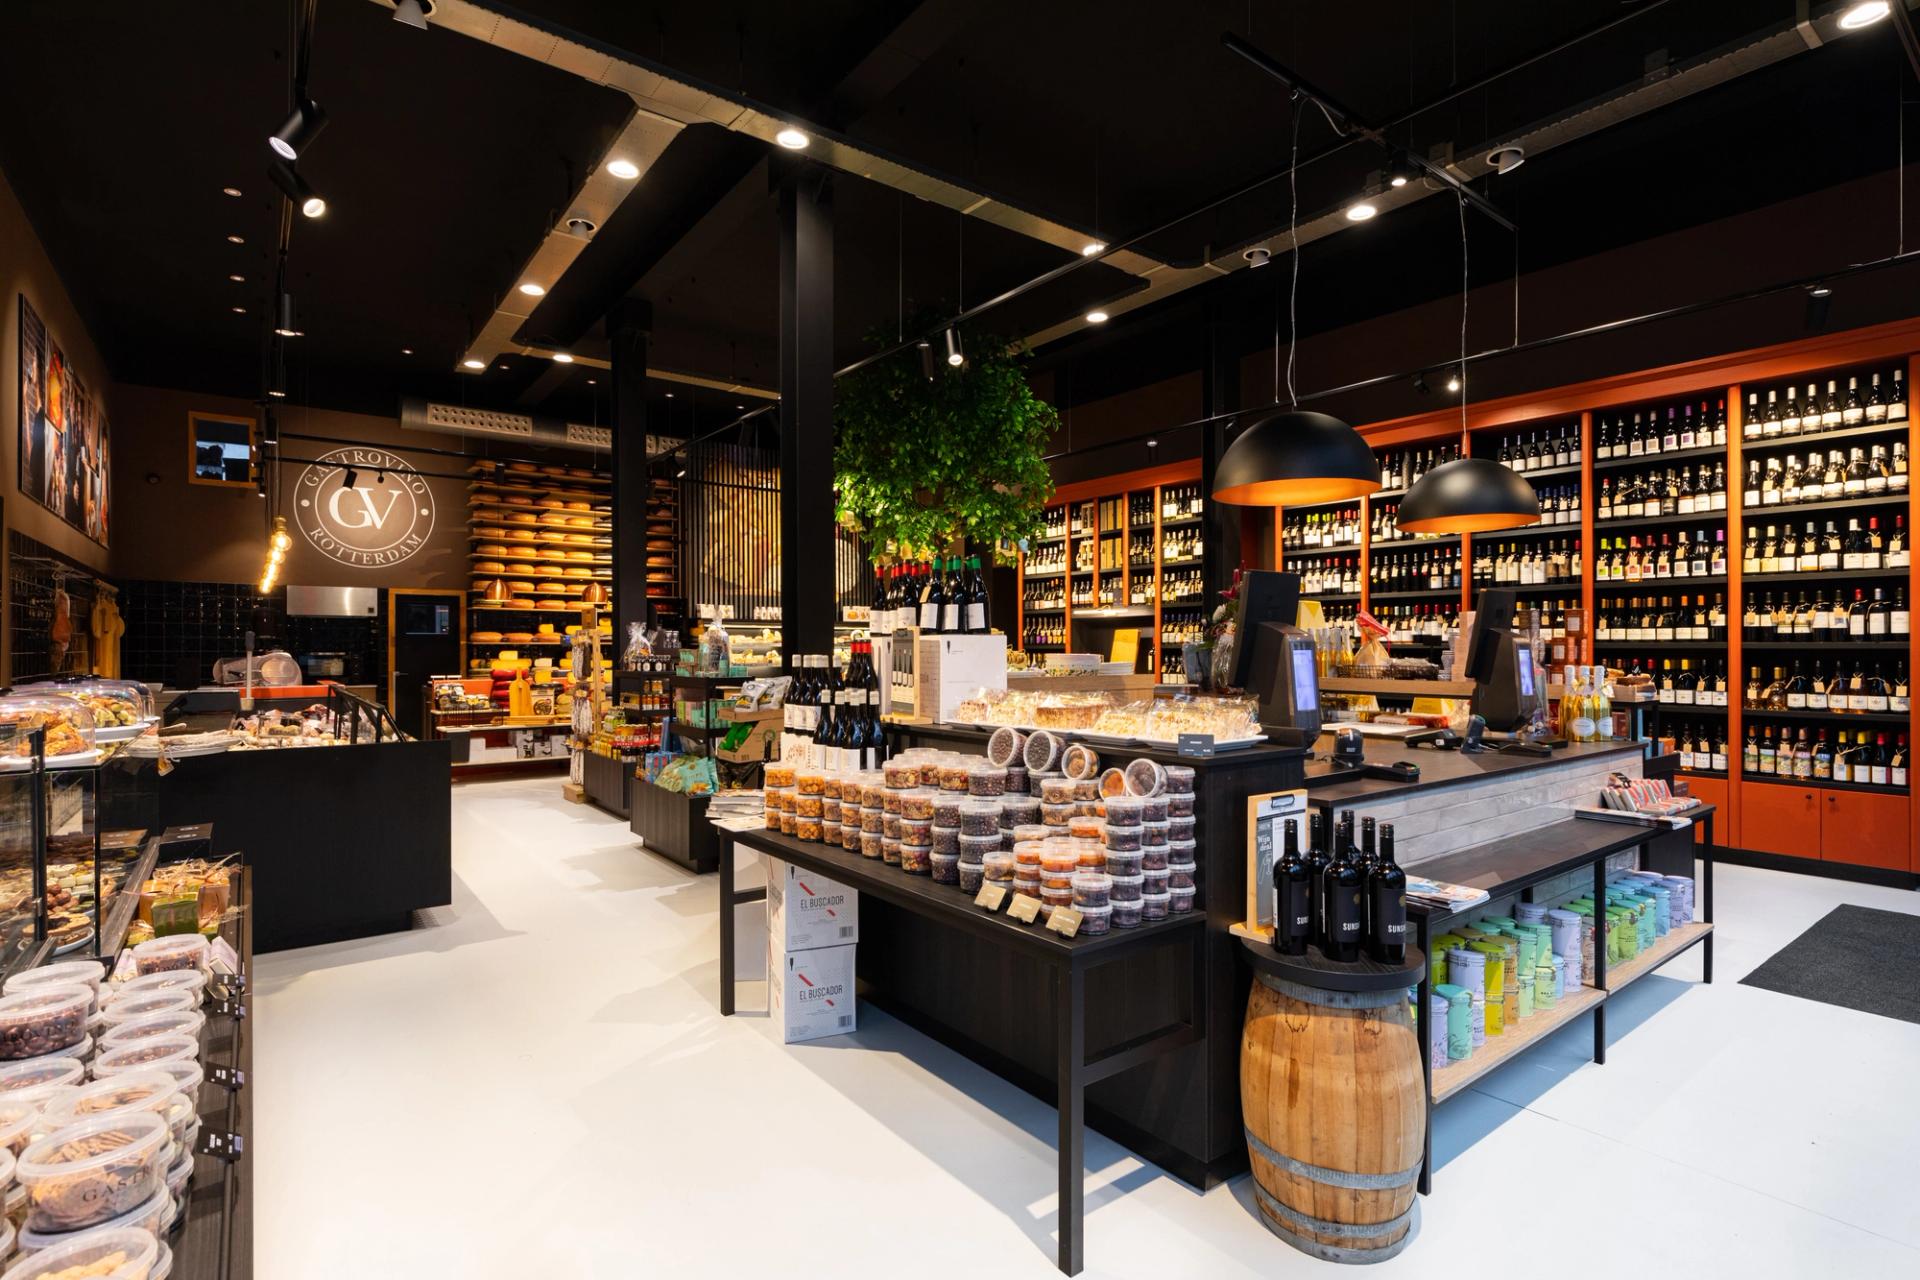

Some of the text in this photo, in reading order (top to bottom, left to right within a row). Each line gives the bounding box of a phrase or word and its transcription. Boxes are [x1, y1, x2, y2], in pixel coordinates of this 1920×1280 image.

[329, 486, 403, 530] GV
[310, 527, 423, 565] ROTTERDAM
[800, 895, 844, 910] EL BUSCADOR
[799, 984, 843, 1001] EL BUSCADOR
